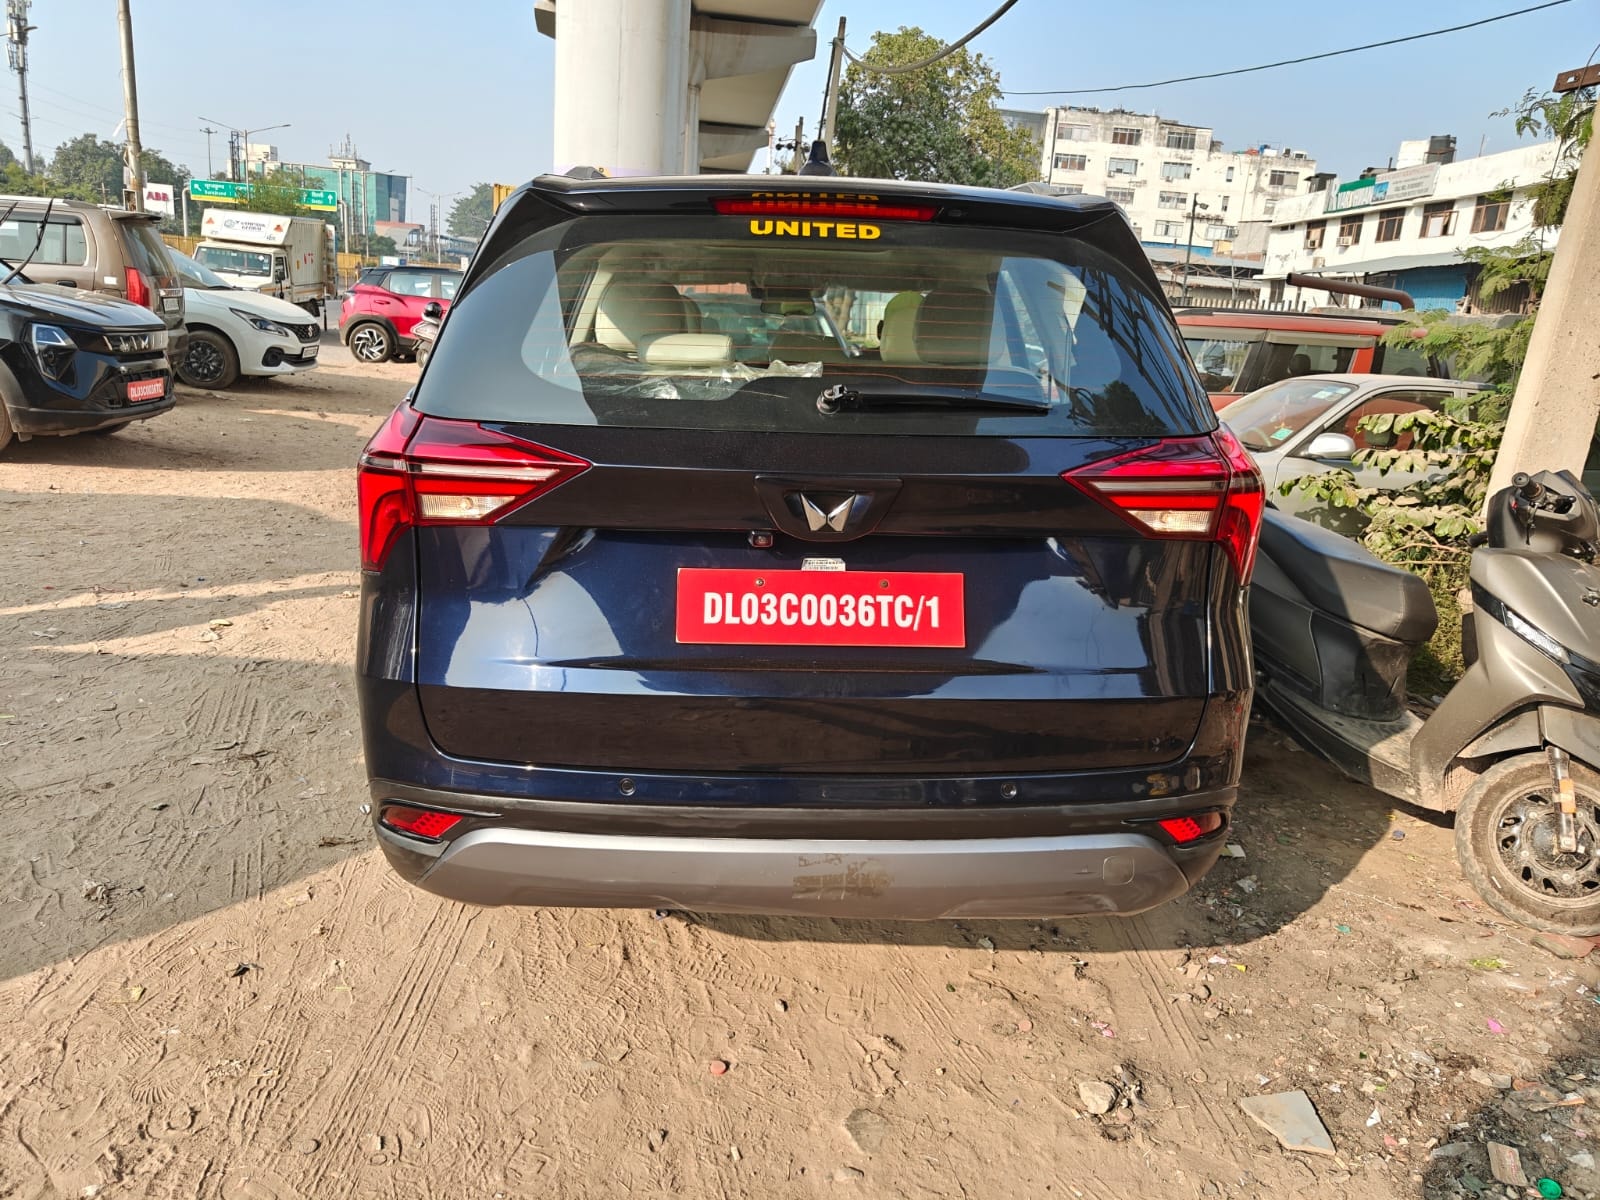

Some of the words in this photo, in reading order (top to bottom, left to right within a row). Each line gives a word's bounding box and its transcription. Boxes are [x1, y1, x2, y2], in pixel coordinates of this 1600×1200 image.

[146, 191, 169, 201] ABB
[750, 220, 881, 240] UNITED
[703, 592, 940, 632] DL03C0036TC/1
